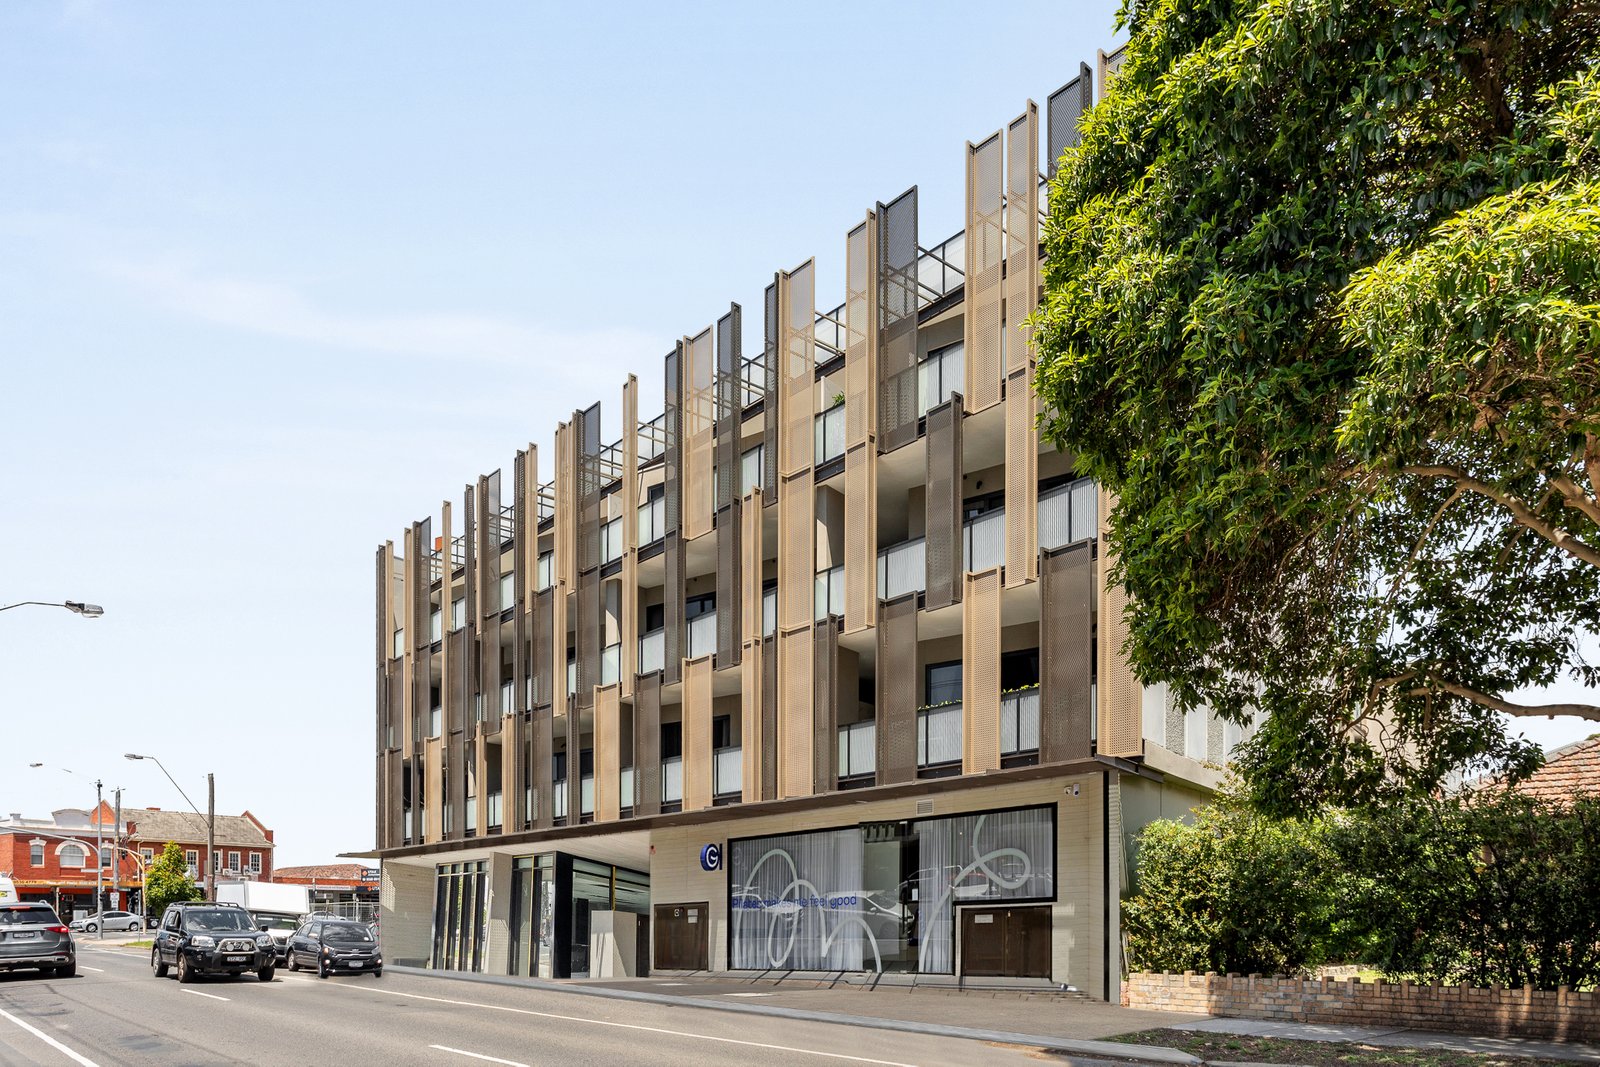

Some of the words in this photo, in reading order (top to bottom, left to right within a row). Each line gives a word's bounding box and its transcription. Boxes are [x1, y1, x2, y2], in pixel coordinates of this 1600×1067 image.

[764, 896, 792, 907] makes
[793, 897, 808, 907] me
[810, 894, 828, 907] feel
[830, 892, 857, 909] good
